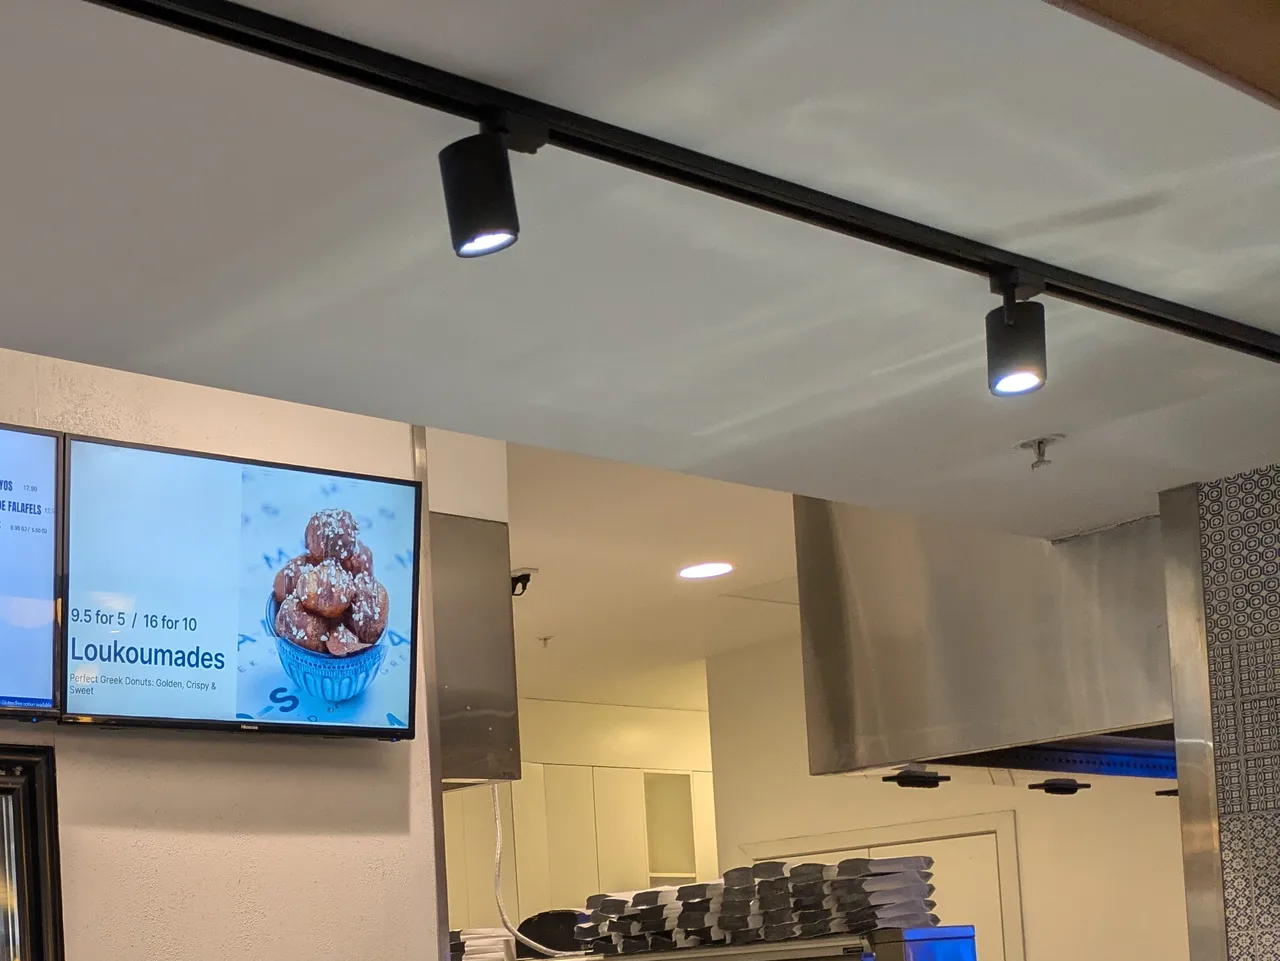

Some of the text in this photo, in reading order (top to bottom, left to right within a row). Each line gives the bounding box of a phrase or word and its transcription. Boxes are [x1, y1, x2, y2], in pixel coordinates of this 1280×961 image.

[8, 501, 41, 515] FALAFELS
[71, 608, 197, 631] 9.5 for 5 / 16 for 10
[71, 637, 225, 670] Loukoumades
[70, 673, 216, 691] Perfect Greek Donuts: Golden, Crispy &
[70, 685, 94, 695] Sweet
